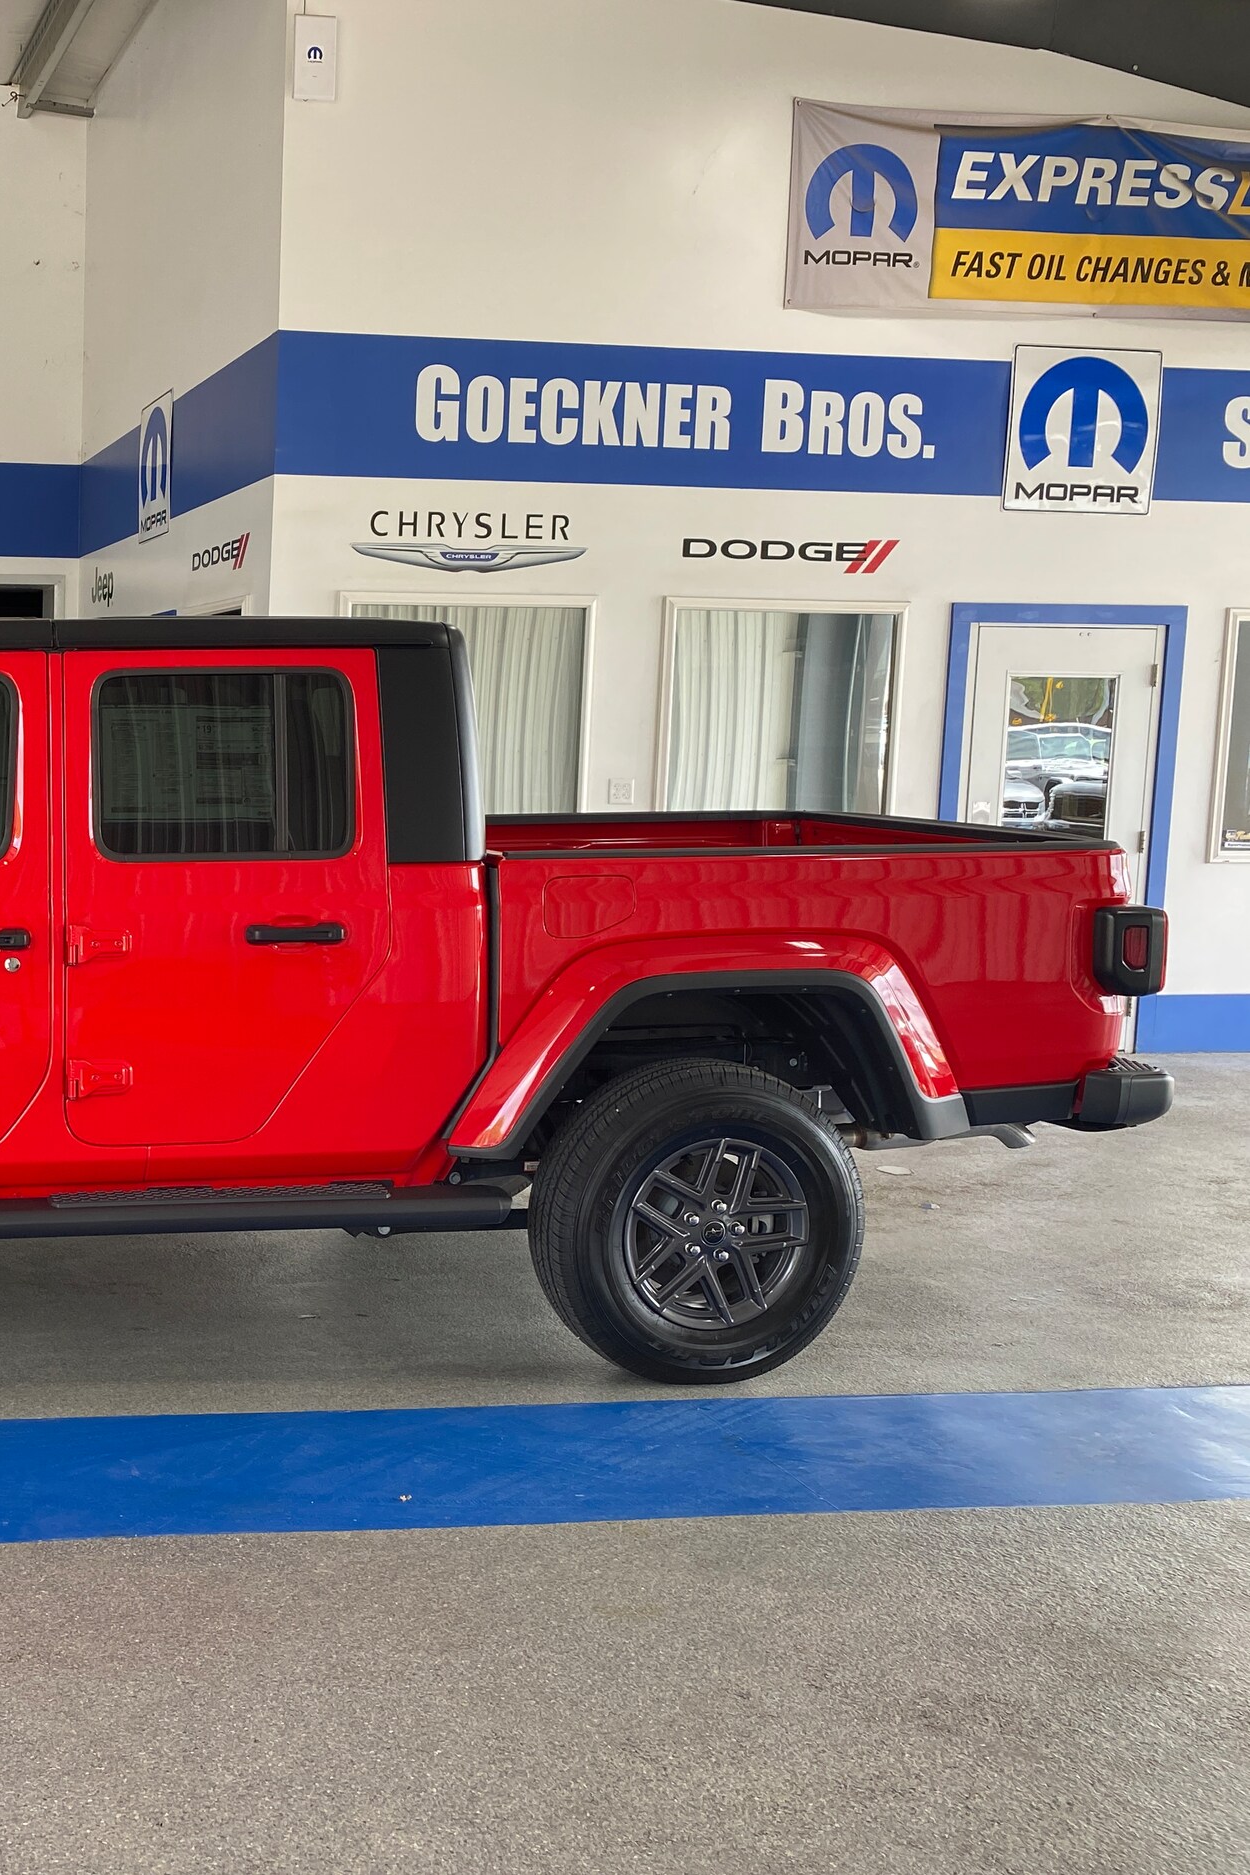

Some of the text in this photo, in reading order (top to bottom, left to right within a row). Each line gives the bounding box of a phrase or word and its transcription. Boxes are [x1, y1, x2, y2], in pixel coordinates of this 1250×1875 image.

[803, 249, 913, 268] MOPAR
[950, 250, 1023, 279] FAST
[1027, 253, 1067, 281] OIL
[1075, 255, 1206, 286] CHANGES
[1211, 260, 1231, 287] &
[414, 363, 936, 460] GOECKNER BROS.
[1014, 481, 1140, 504] MOPAR
[141, 508, 167, 534] MOPAR
[369, 510, 571, 541] CHRYSLER
[191, 538, 241, 572] DODGE
[681, 537, 868, 563] DODGE
[91, 566, 114, 607] Jeep
